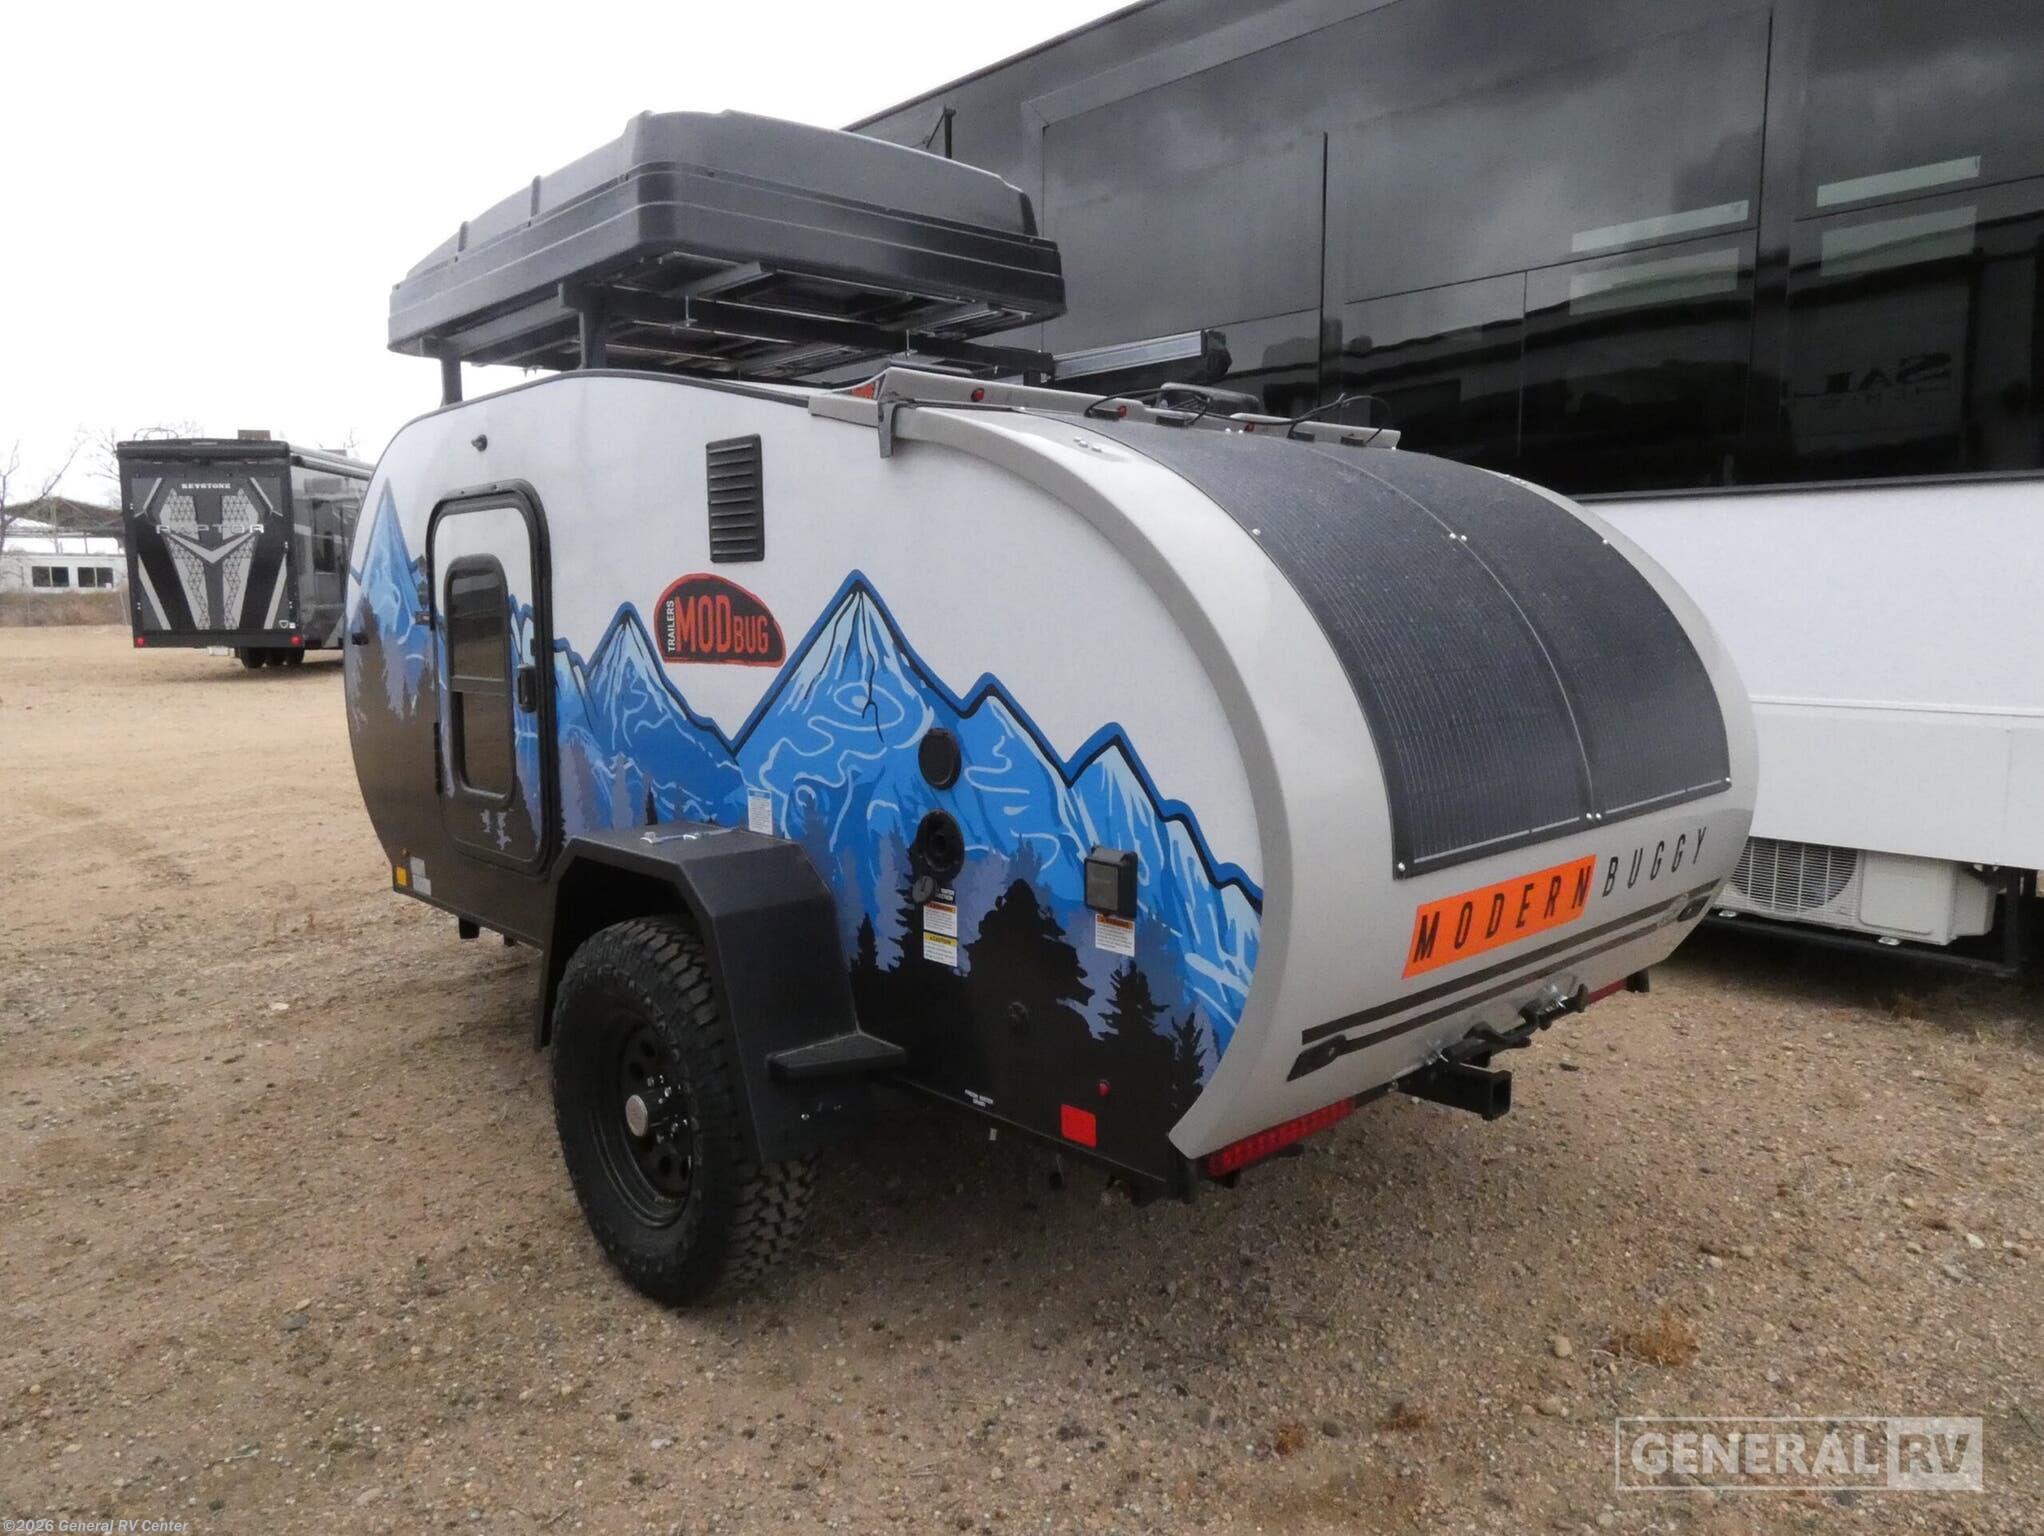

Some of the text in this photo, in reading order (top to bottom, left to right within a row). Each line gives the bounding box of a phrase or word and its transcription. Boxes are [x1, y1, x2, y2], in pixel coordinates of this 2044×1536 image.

[666, 600, 675, 652] TRAILERS
[1413, 826, 1707, 963] MODERN BUGGY
